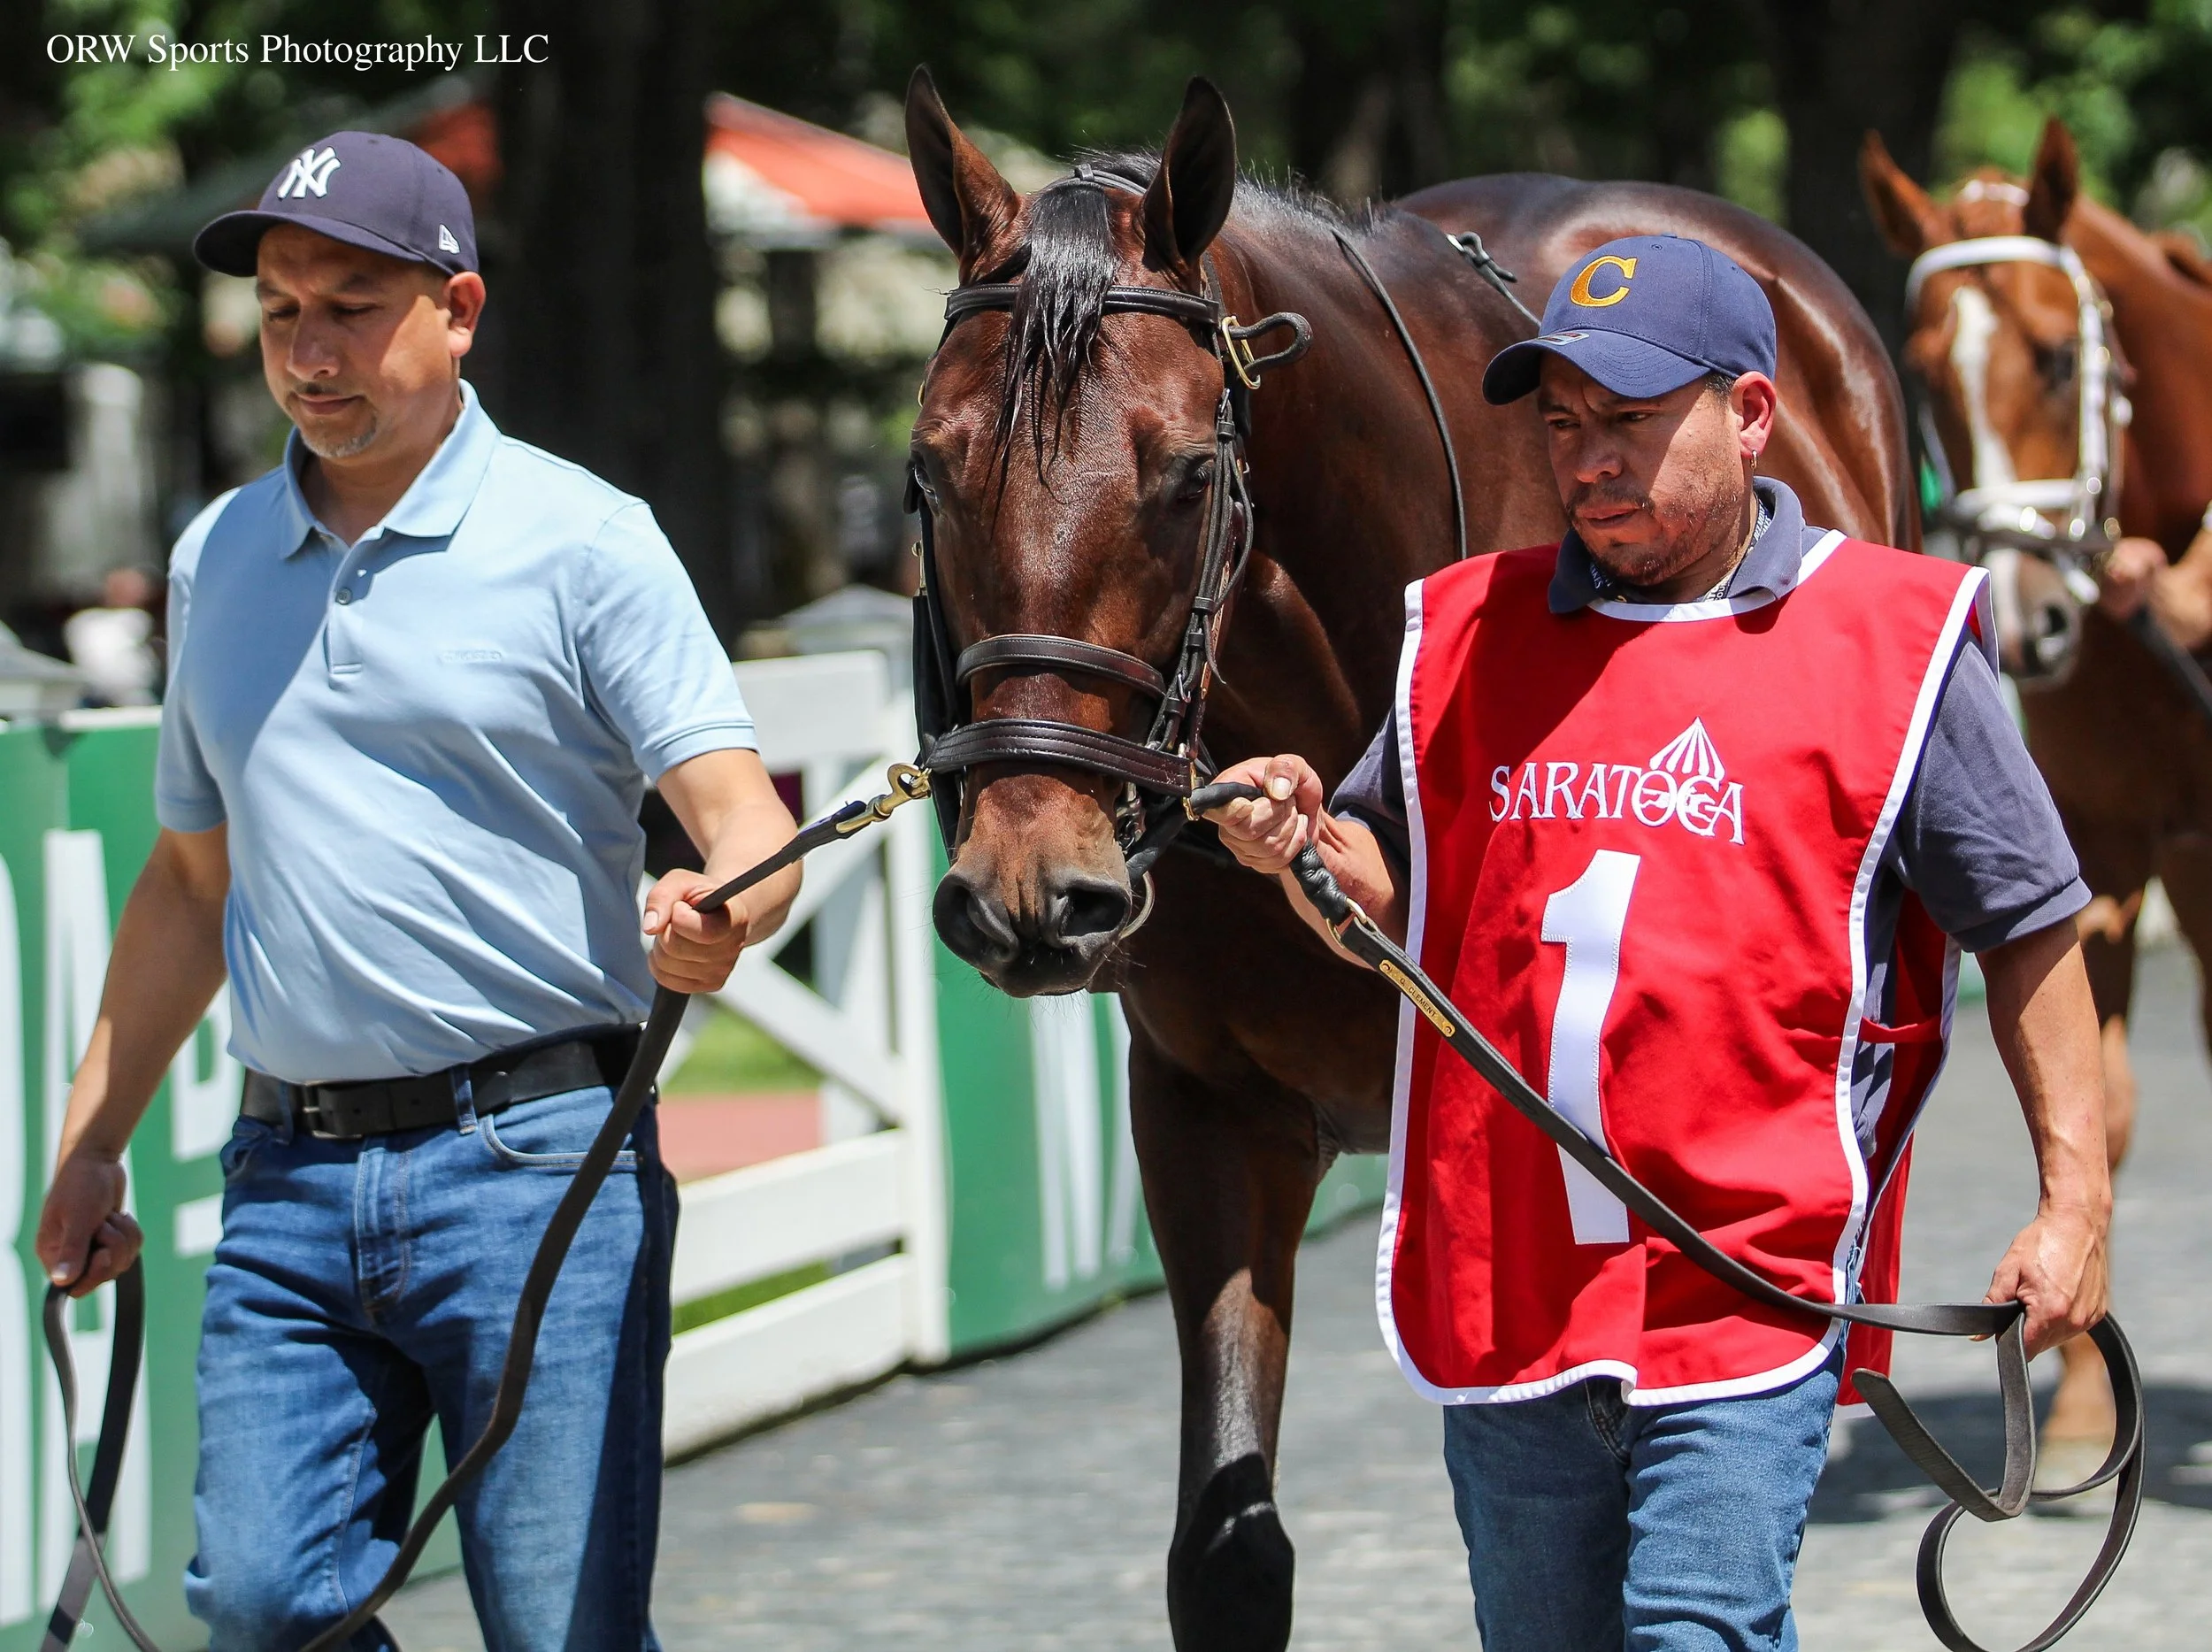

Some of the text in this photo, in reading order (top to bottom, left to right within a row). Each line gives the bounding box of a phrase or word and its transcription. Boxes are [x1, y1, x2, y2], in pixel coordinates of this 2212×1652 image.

[277, 146, 342, 199] NY
[1570, 255, 1638, 308] C
[1489, 762, 1745, 845] SARATOGA
[1408, 987, 1437, 1018] CLEMENT
[1541, 849, 1640, 1245] 1
